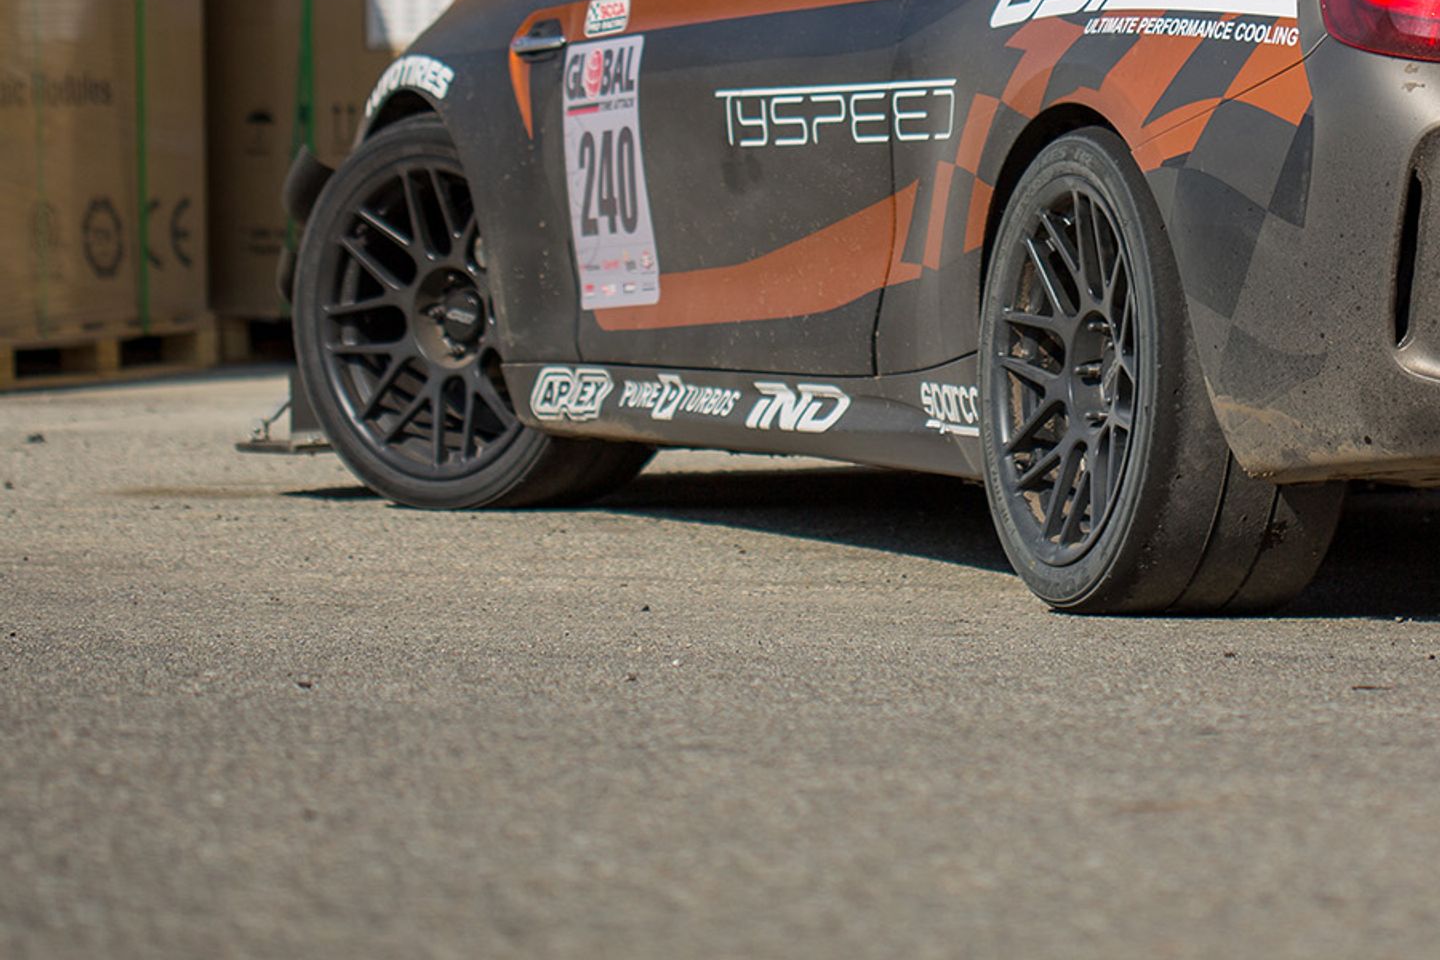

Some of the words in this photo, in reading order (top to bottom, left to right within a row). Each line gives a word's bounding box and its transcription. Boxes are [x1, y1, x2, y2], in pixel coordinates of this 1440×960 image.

[1083, 16, 1138, 35] ULTIMATE
[1137, 18, 1236, 41] PERFORMANCE
[1234, 23, 1300, 47] COOLING
[578, 127, 639, 237] 240
[534, 373, 609, 415] APEX
[618, 380, 662, 408] PURE
[680, 384, 741, 417] TURBOS
